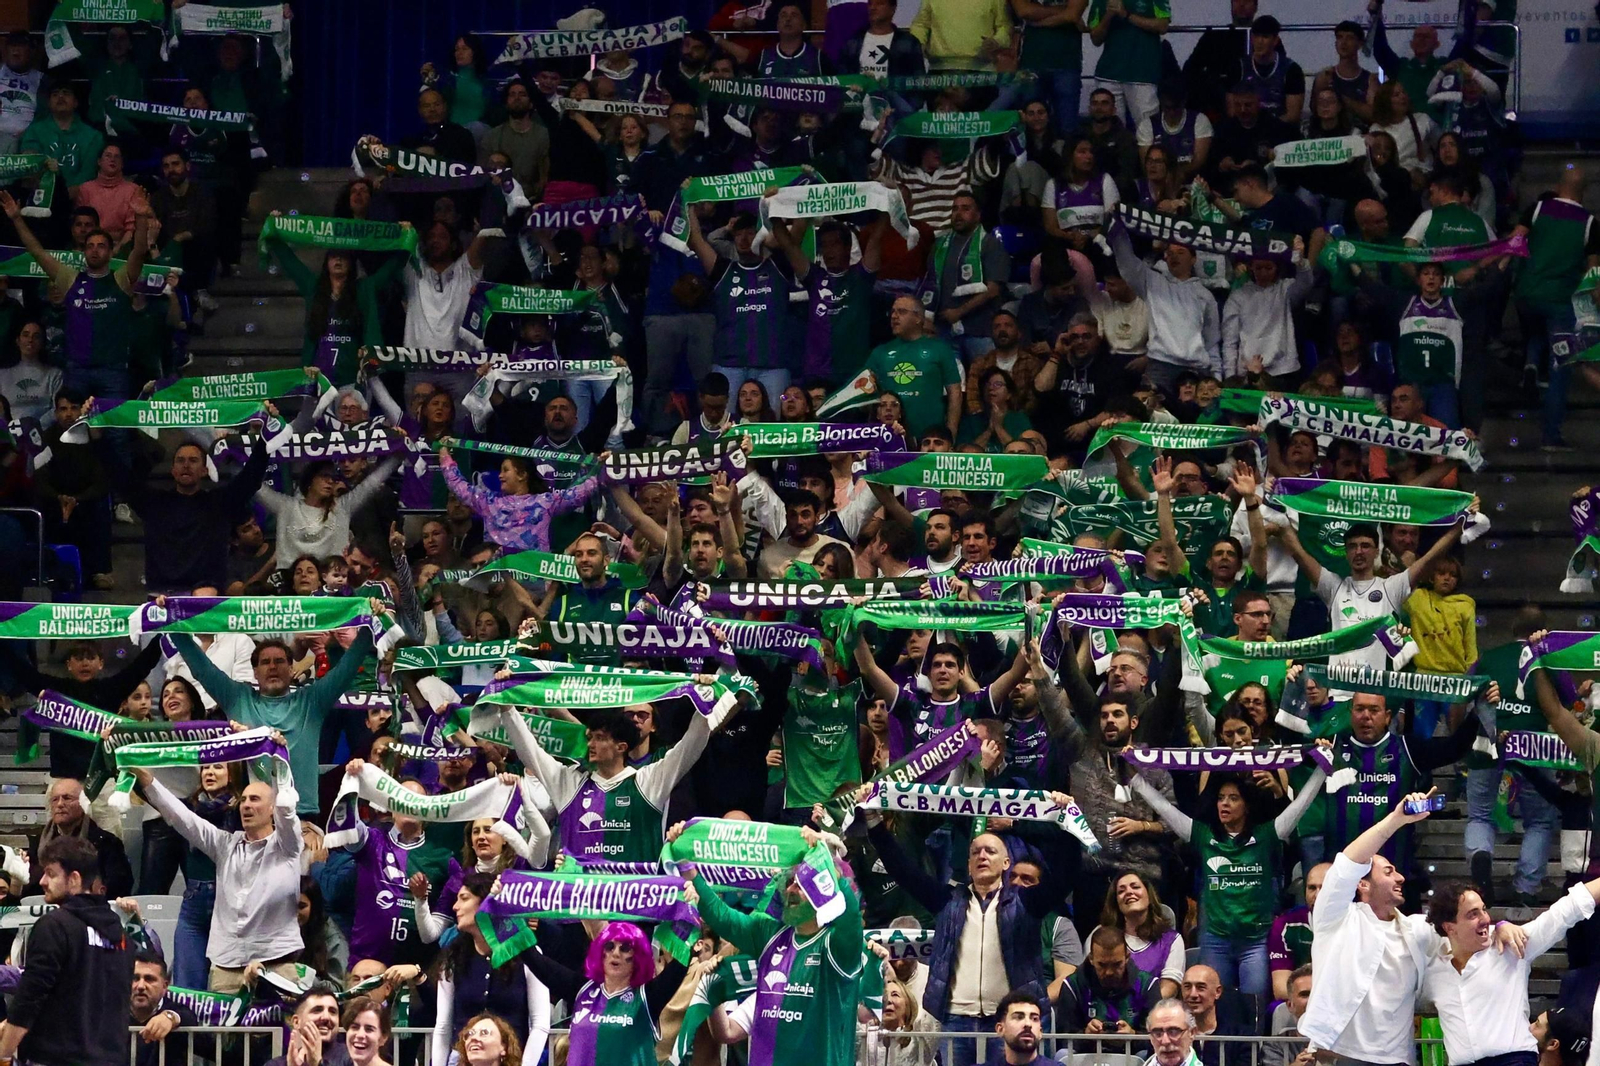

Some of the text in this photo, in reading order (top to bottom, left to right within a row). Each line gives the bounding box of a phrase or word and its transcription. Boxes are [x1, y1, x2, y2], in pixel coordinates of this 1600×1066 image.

[72, 9, 137, 20] BALONCESTO
[540, 25, 649, 46] UNICAJA
[754, 83, 826, 104] BALONCESTO
[151, 103, 187, 117] TIENE
[190, 108, 207, 119] UN
[932, 112, 980, 122] UNICAJA
[922, 120, 990, 134] BALONCESTO
[397, 150, 498, 178] UNICA
[274, 217, 333, 236] UNICAJA
[1119, 203, 1253, 256] UNICAJA
[512, 285, 562, 298] UNICAJA
[501, 297, 574, 311] BALONCESTO
[330, 348, 340, 367] 7
[374, 346, 511, 365] UNICAJA
[202, 373, 255, 387] UNICAJA
[192, 382, 267, 399] BALONCESTO
[138, 408, 219, 425] BALONCESTO
[1304, 401, 1431, 438] UNICAJA
[802, 421, 893, 444] Baloncesto
[479, 441, 581, 462] UNICAJA BALONCESTO
[936, 456, 993, 471] UNICAJA
[922, 469, 1005, 488] BALONCESTO
[1339, 485, 1398, 503] UNICAJA
[1142, 498, 1212, 516] Uicaja
[1326, 498, 1411, 520] BALONCESTO
[962, 557, 1037, 578] BALONCES
[729, 582, 900, 606] UNICAJA
[52, 605, 112, 619] UNICAJA
[241, 599, 303, 614] UNICAJA
[1057, 606, 1142, 624] Balonces
[39, 617, 126, 635] BALONCESTO
[228, 613, 317, 631] BALONCESTO
[550, 621, 711, 648] UNICAJA
[723, 622, 809, 649] BALONCESTO
[448, 639, 517, 658] Unicaja
[1243, 638, 1335, 657] BALONCESTO
[400, 651, 424, 666] Unicaja
[560, 676, 622, 689] UNICAJA
[1327, 665, 1472, 696] UNICAJA BALONCESTO
[544, 687, 634, 704] BALONCESTO
[387, 741, 472, 759] UNICAJA
[895, 725, 969, 783] BALONCEST
[1133, 744, 1303, 765] UNICAJA
[1358, 772, 1396, 785] Unicaja
[1346, 791, 1389, 806] málaga
[600, 819, 632, 831] Unicaja
[708, 822, 769, 843] UNICAJA
[584, 842, 625, 855] málaga
[693, 839, 780, 864] BALONCESTO
[1229, 863, 1263, 876] Unicaja
[497, 877, 679, 916] NICAJA BALONCESTO
[390, 916, 409, 942] 15
[783, 982, 815, 995] Unicaja
[589, 1012, 634, 1027] Unicaja
[761, 1004, 803, 1022] málaga
